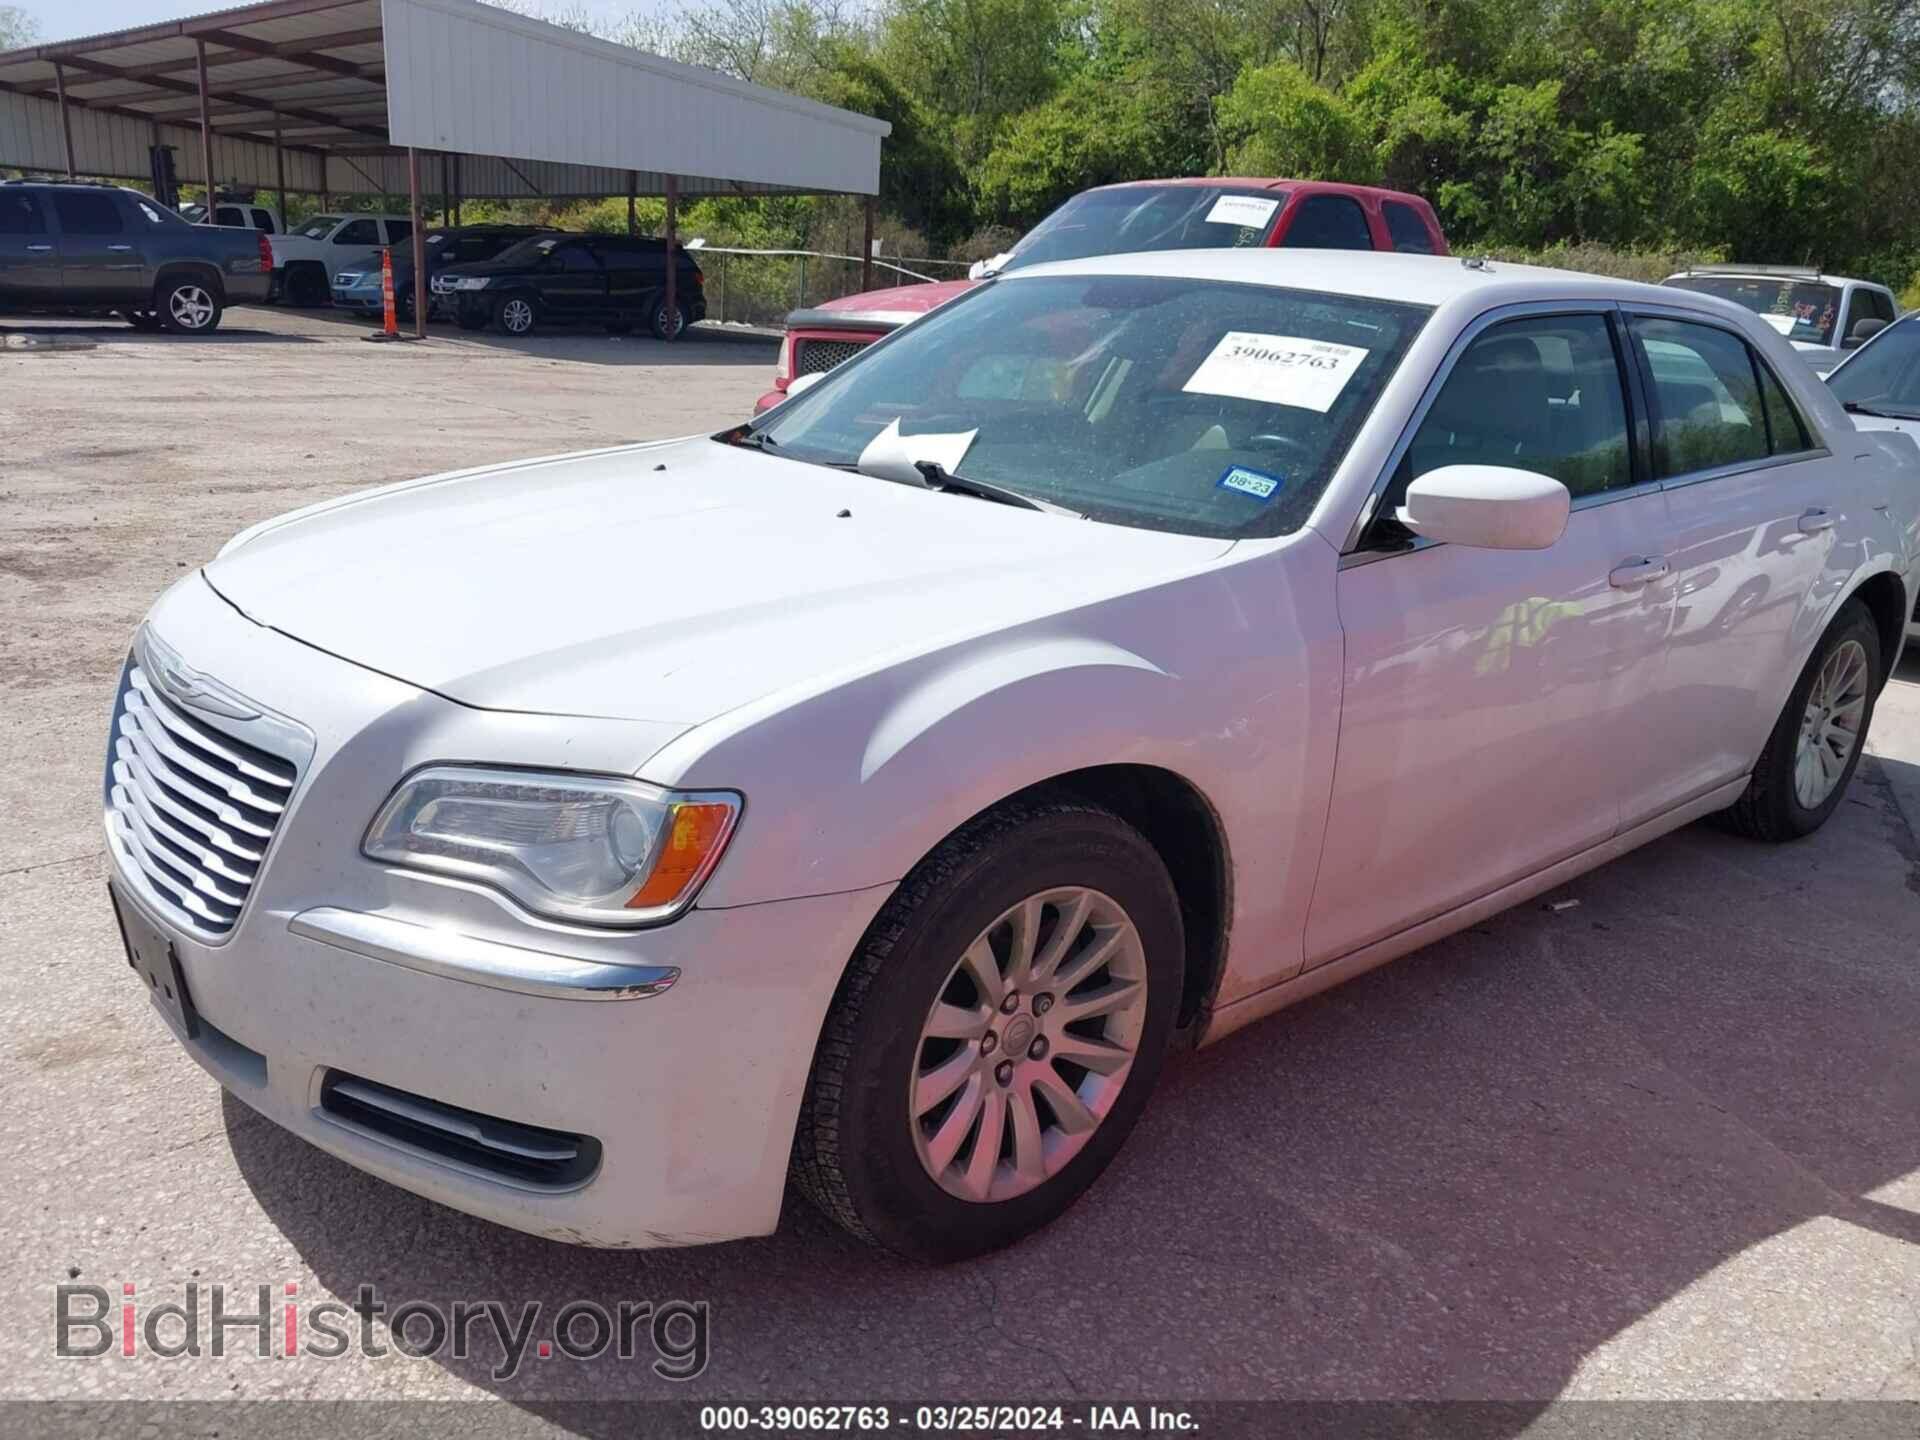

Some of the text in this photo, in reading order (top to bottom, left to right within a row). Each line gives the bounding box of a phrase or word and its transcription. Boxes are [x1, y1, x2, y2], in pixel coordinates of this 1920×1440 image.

[1225, 345, 1339, 370] 39062763
[1229, 475, 1271, 493] 08 23
